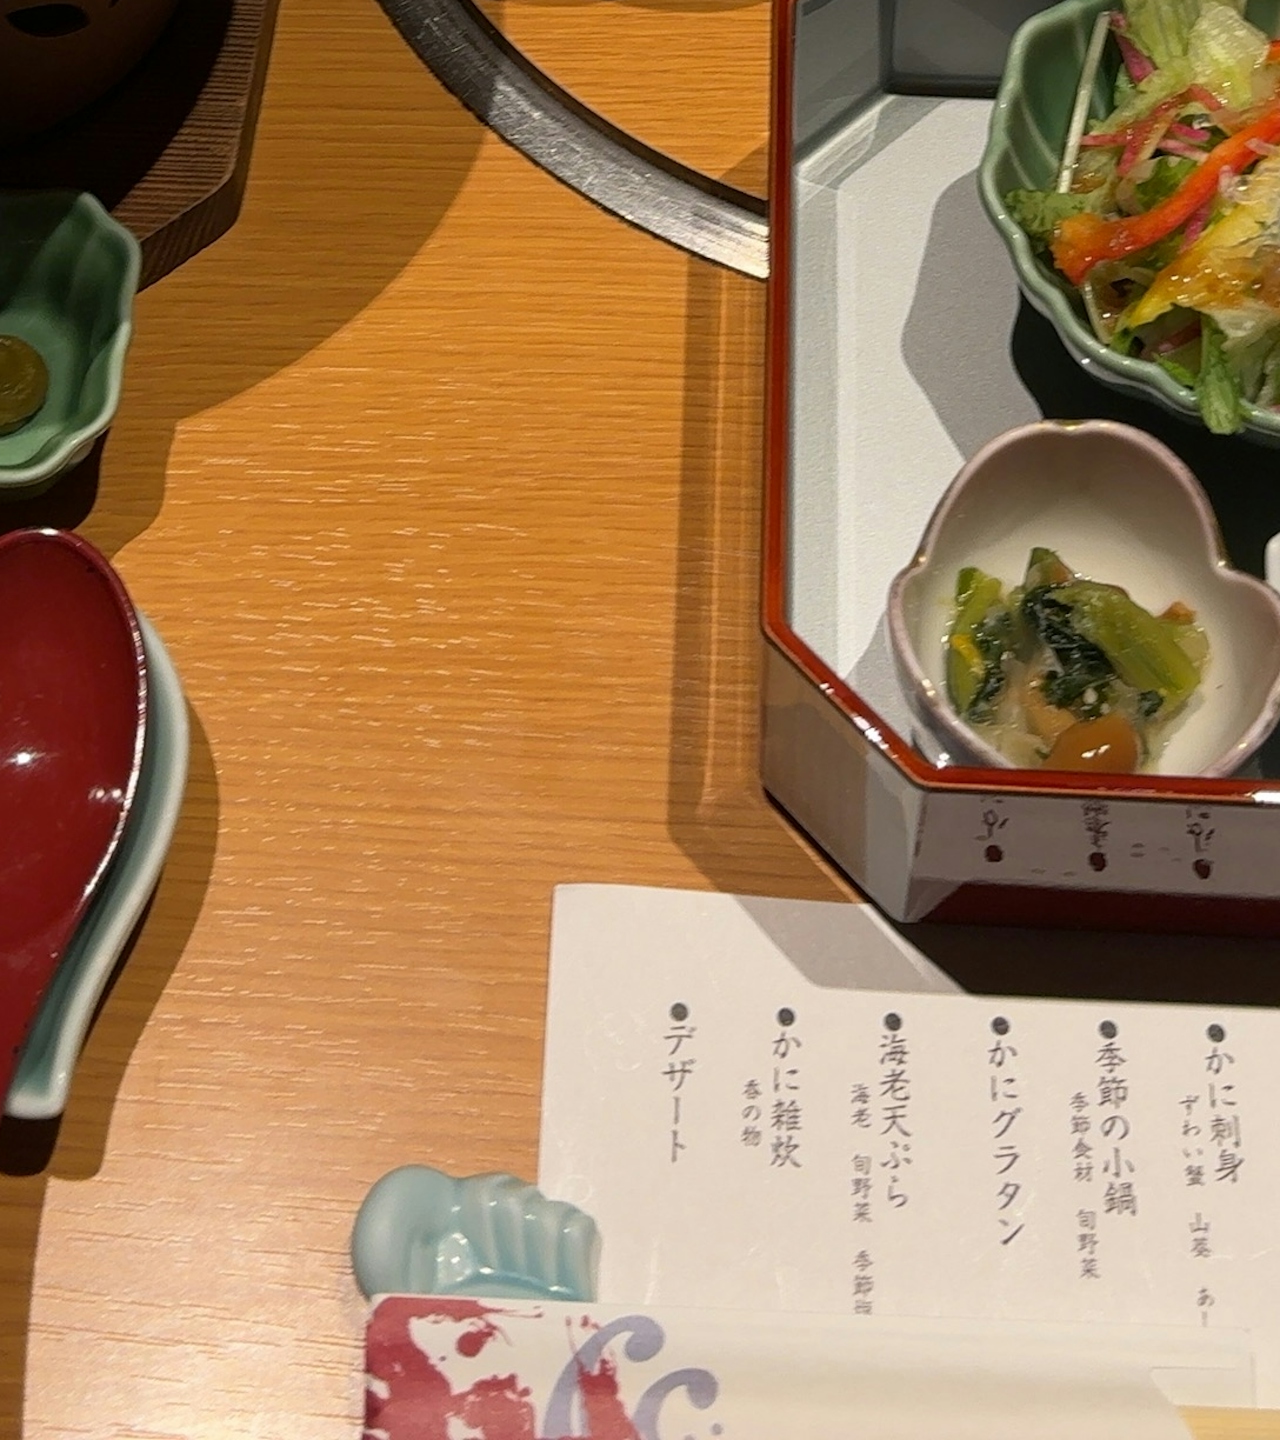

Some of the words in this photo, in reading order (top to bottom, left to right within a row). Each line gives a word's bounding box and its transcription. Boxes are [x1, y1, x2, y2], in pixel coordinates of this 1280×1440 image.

[662, 1025, 698, 1163] デザート
[769, 1032, 803, 1168] かに雑炊
[850, 1083, 873, 1129] 海老
[878, 1034, 913, 1209] 海老天ぷら
[987, 1040, 1024, 1247] かにグラタン
[1094, 1041, 1138, 1217] 季節の小鍋
[1179, 1094, 1205, 1187] ずわい蟹
[1205, 1046, 1245, 1184] かに刺身
[851, 1153, 874, 1223] 旬野菜
[1075, 1208, 1101, 1280] 旬野菜
